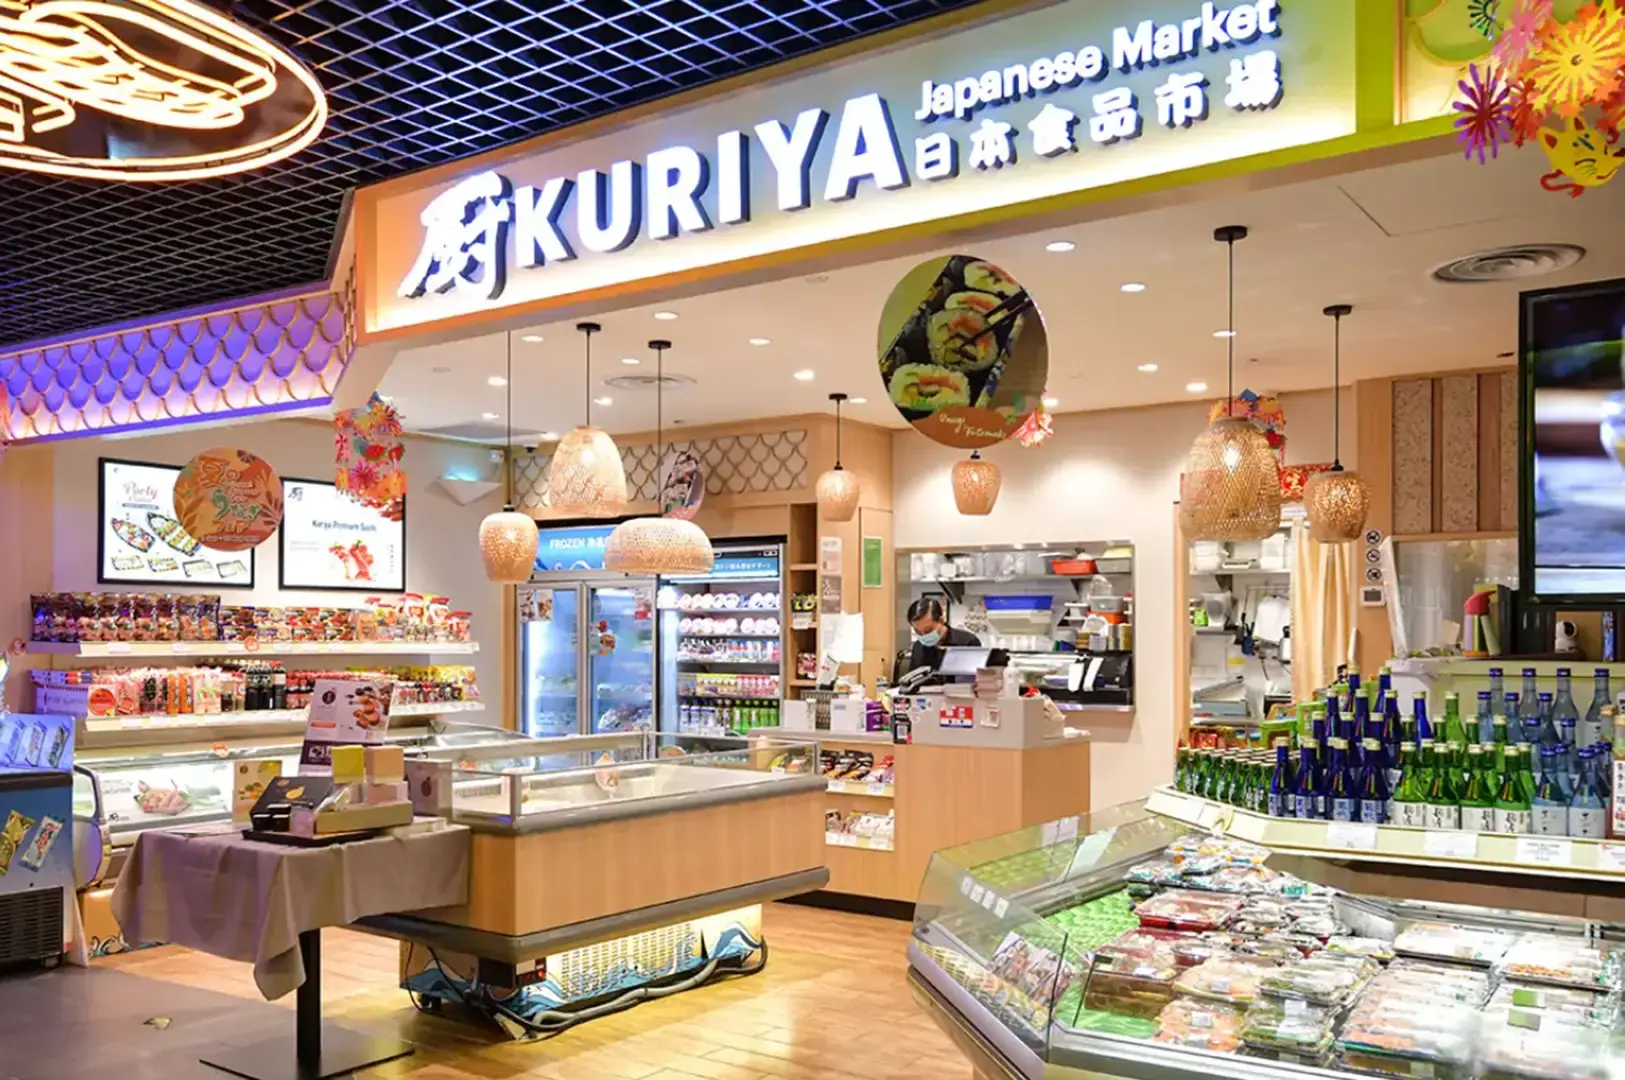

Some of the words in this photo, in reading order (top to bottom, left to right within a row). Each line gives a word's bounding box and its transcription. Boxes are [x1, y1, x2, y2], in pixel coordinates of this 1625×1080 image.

[914, 45, 1109, 121] Japanese
[1112, 0, 1282, 72] Market
[914, 50, 1283, 181] 日本食品市場
[513, 92, 909, 268] KURIYA
[123, 481, 159, 500] Party
[549, 537, 586, 549] FROZEN
